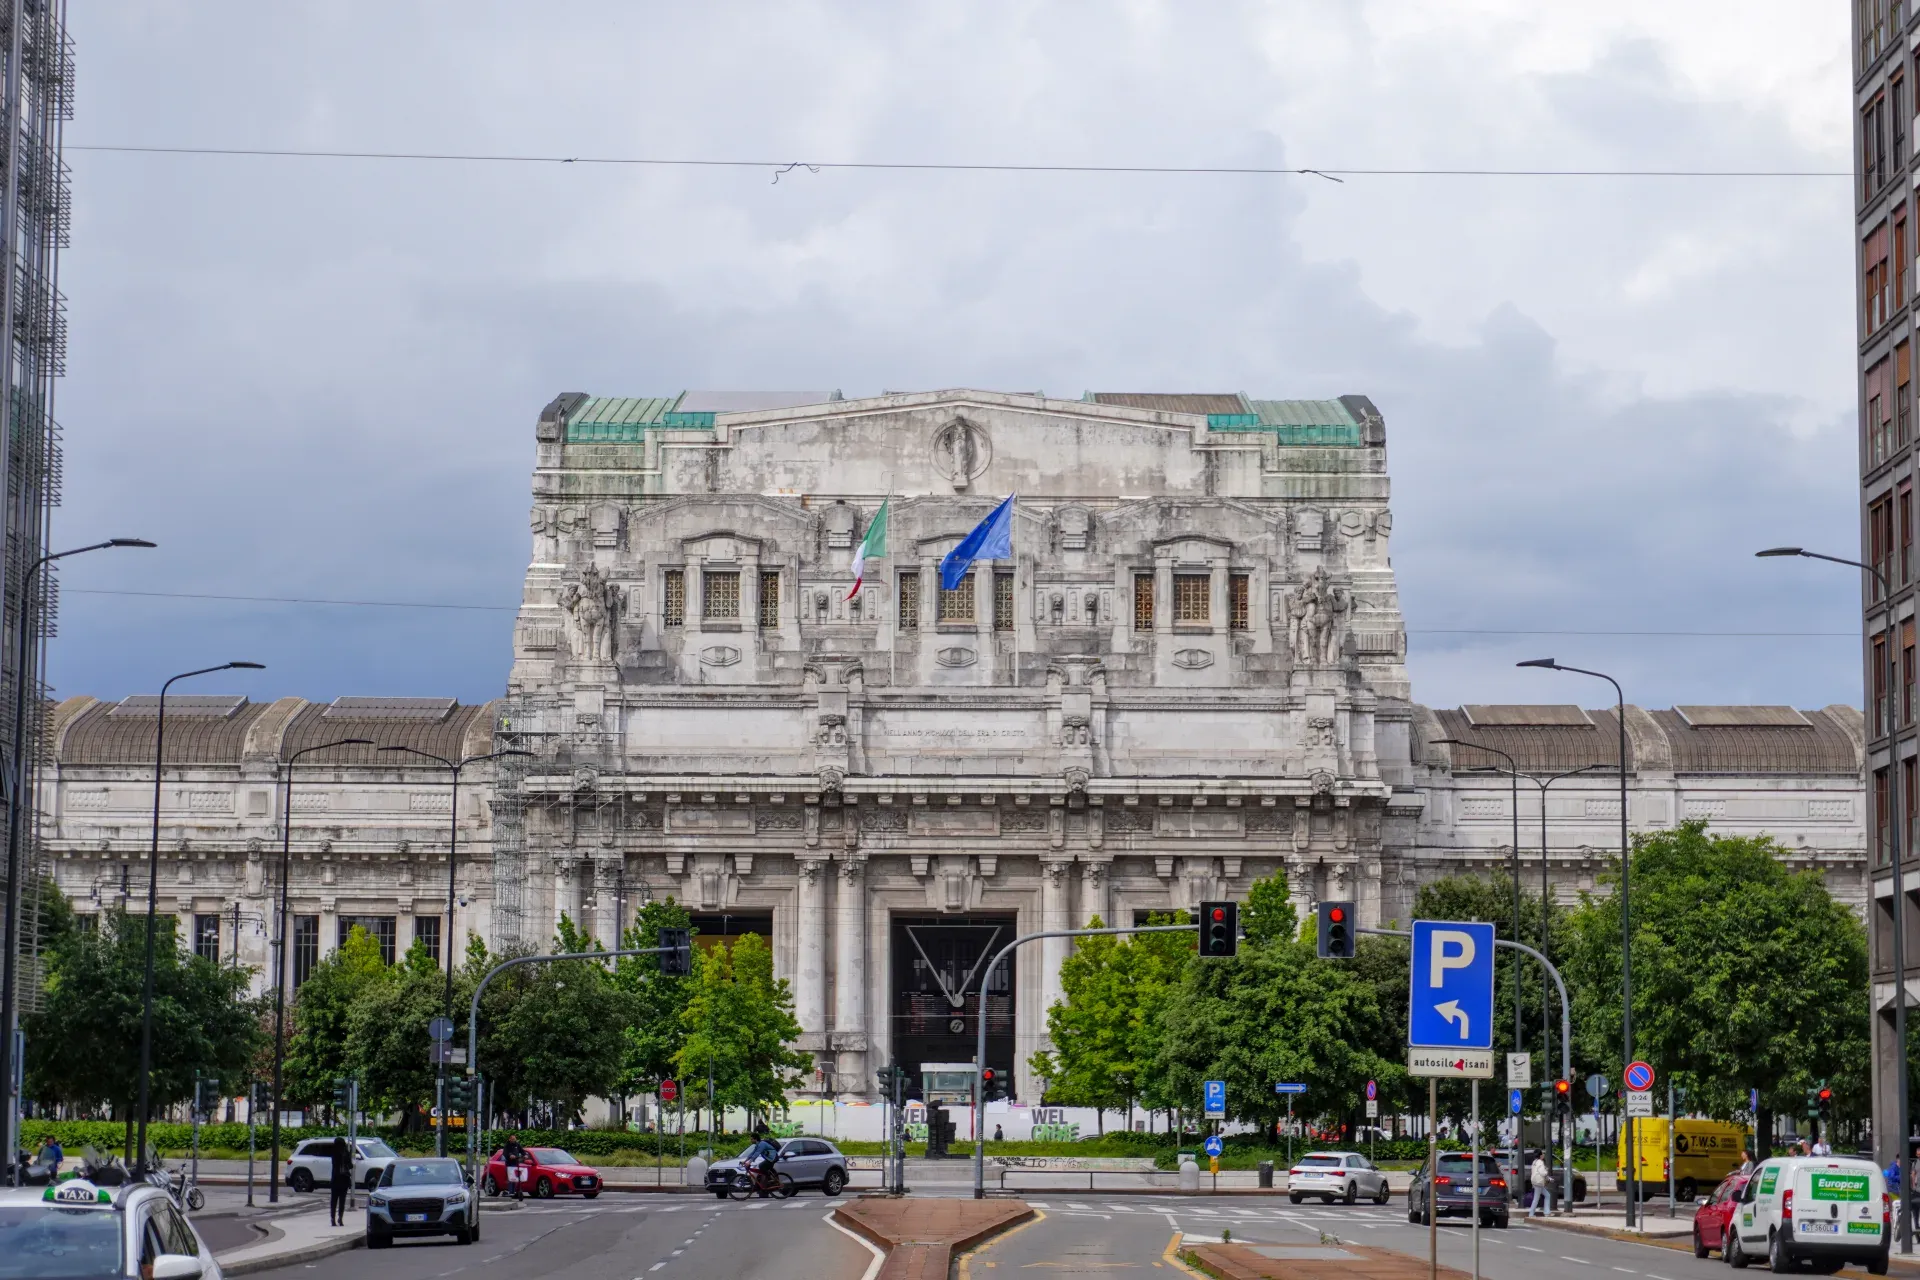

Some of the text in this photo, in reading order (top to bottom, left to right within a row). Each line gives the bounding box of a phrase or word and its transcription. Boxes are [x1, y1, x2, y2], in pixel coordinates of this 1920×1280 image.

[1430, 930, 1475, 988] P
[1414, 1057, 1489, 1070] autosilo isani
[1209, 1083, 1220, 1098] P
[1031, 1108, 1068, 1124] WEL
[1690, 1136, 1719, 1148] T.W.S.
[1818, 1178, 1864, 1191] Europcar
[63, 1189, 89, 1200] TAXI
